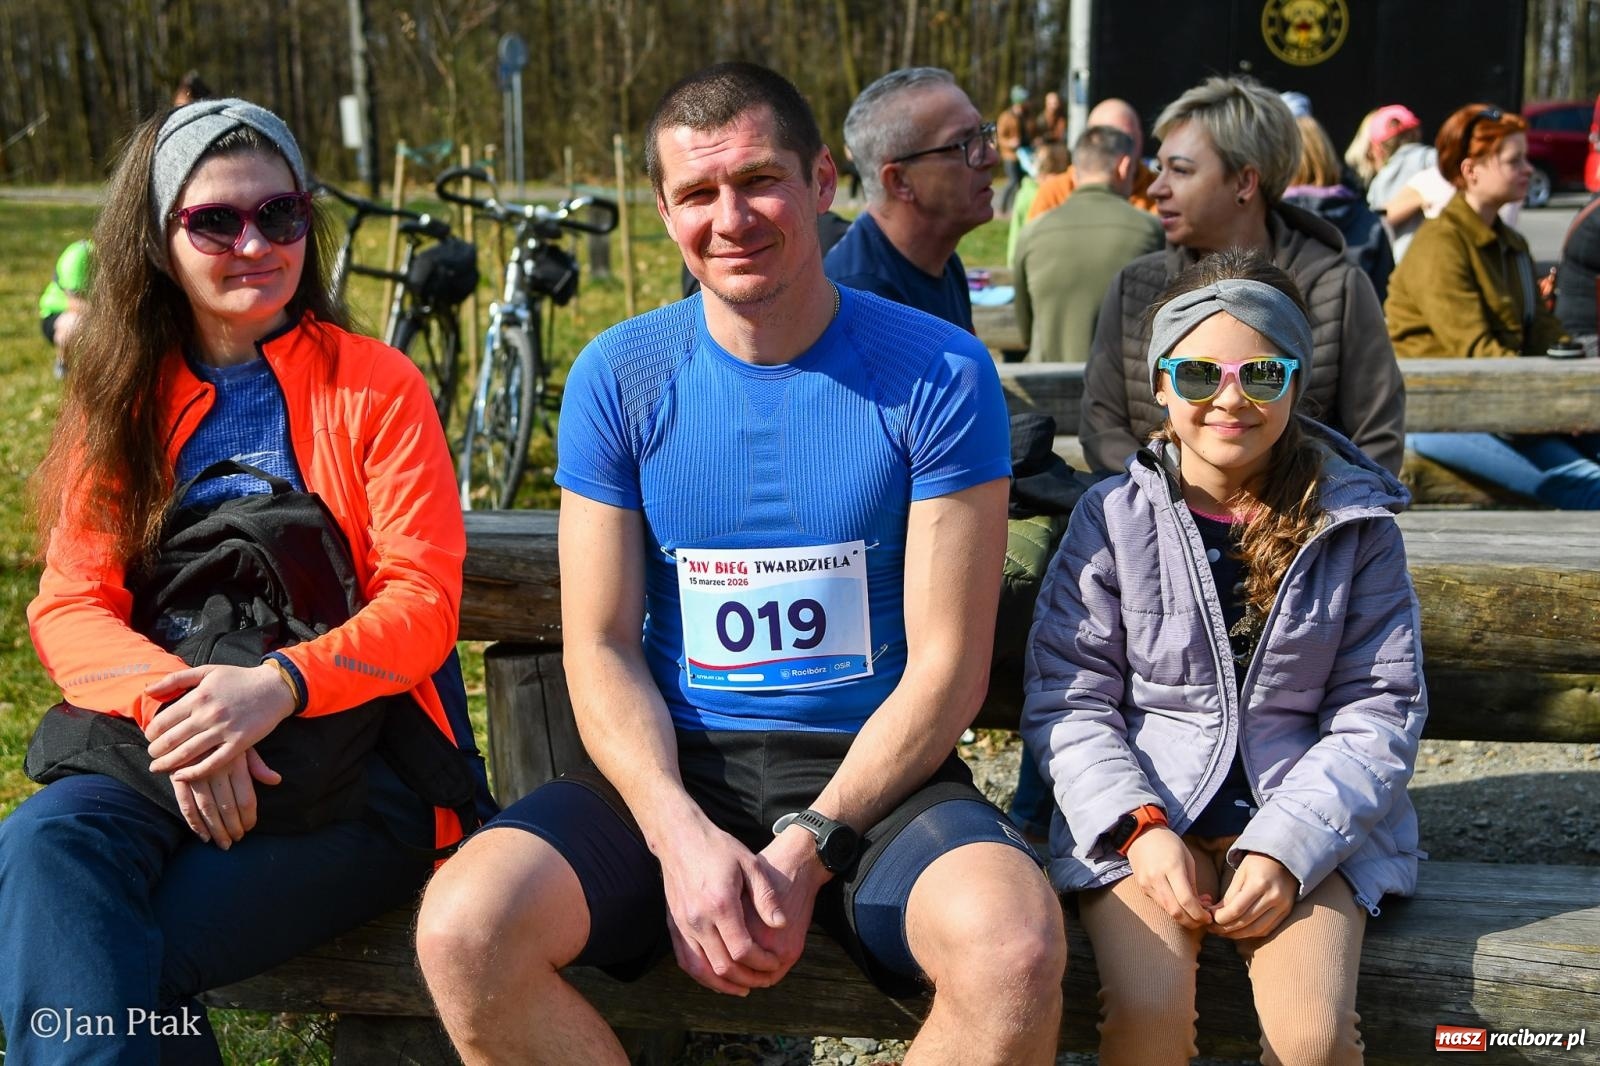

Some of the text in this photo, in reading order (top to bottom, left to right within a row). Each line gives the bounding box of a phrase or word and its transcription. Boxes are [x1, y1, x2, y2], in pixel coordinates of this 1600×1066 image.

[689, 555, 850, 575] XIV BIEG TWARDZIELA
[689, 577, 697, 585] 15
[716, 599, 826, 653] 019
[792, 667, 827, 676] Racibórz
